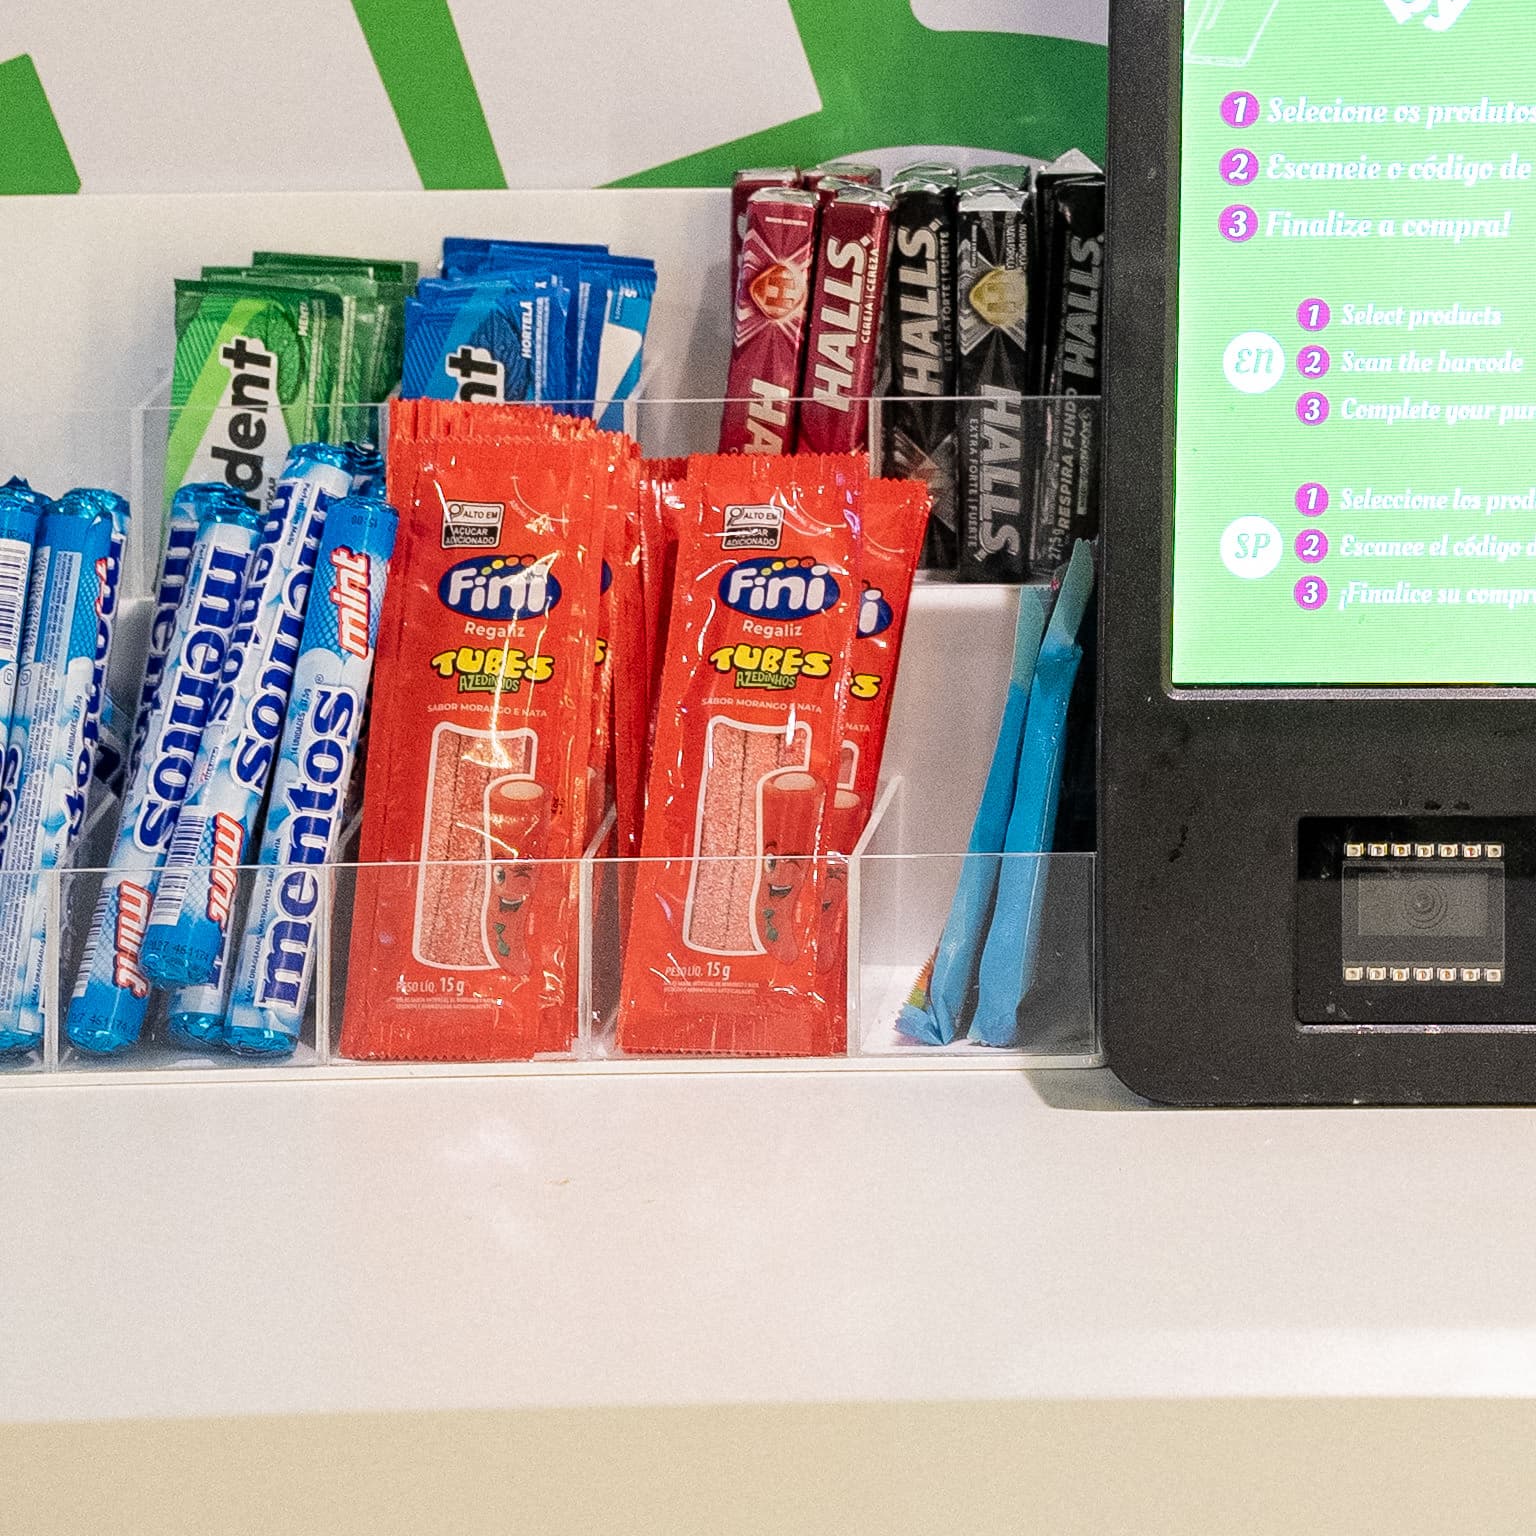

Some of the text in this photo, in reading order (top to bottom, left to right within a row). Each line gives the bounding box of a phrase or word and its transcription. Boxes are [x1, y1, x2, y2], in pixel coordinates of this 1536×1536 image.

[1266, 96, 1388, 125] Selecione
[1394, 103, 1420, 125] os
[1266, 153, 1383, 181] Escaneie
[1408, 152, 1493, 188] código
[1500, 152, 1532, 181] de
[1264, 210, 1512, 245] Finalize compra!
[860, 247, 881, 345] CEREJA CEREZA
[1340, 303, 1503, 331] Select products
[1340, 351, 1524, 375] Scan the barcode
[1340, 398, 1441, 426] Complete
[1446, 402, 1495, 426] your
[1058, 388, 1078, 530] RESPIRA FUNDO
[966, 418, 980, 548] EXTRA FORTE FUERTE
[1340, 487, 1448, 512] Seleccione
[1453, 487, 1482, 512] los
[445, 534, 496, 546] ADICIONADO
[725, 536, 776, 547] ADICIONADO
[1234, 533, 1271, 559] SP
[1340, 534, 1425, 558] Escanee
[1430, 534, 1448, 558] el
[1453, 534, 1522, 563] código
[448, 564, 549, 613] Fini
[728, 564, 830, 612] Fini
[1338, 581, 1431, 611] ¡Finalice
[1436, 588, 1461, 605] su
[329, 546, 371, 660] mint
[464, 621, 526, 640] Regaliz
[741, 621, 804, 639] Regaliz
[431, 646, 555, 683] TUBES
[708, 643, 834, 678] TUBES
[133, 544, 254, 853] mentos
[427, 702, 458, 714] SABOR
[702, 697, 823, 715] SABOR MORANGO NATA
[259, 689, 355, 1006] mentos
[112, 880, 152, 997] mint
[706, 961, 721, 978] 15
[440, 976, 455, 993] 15
